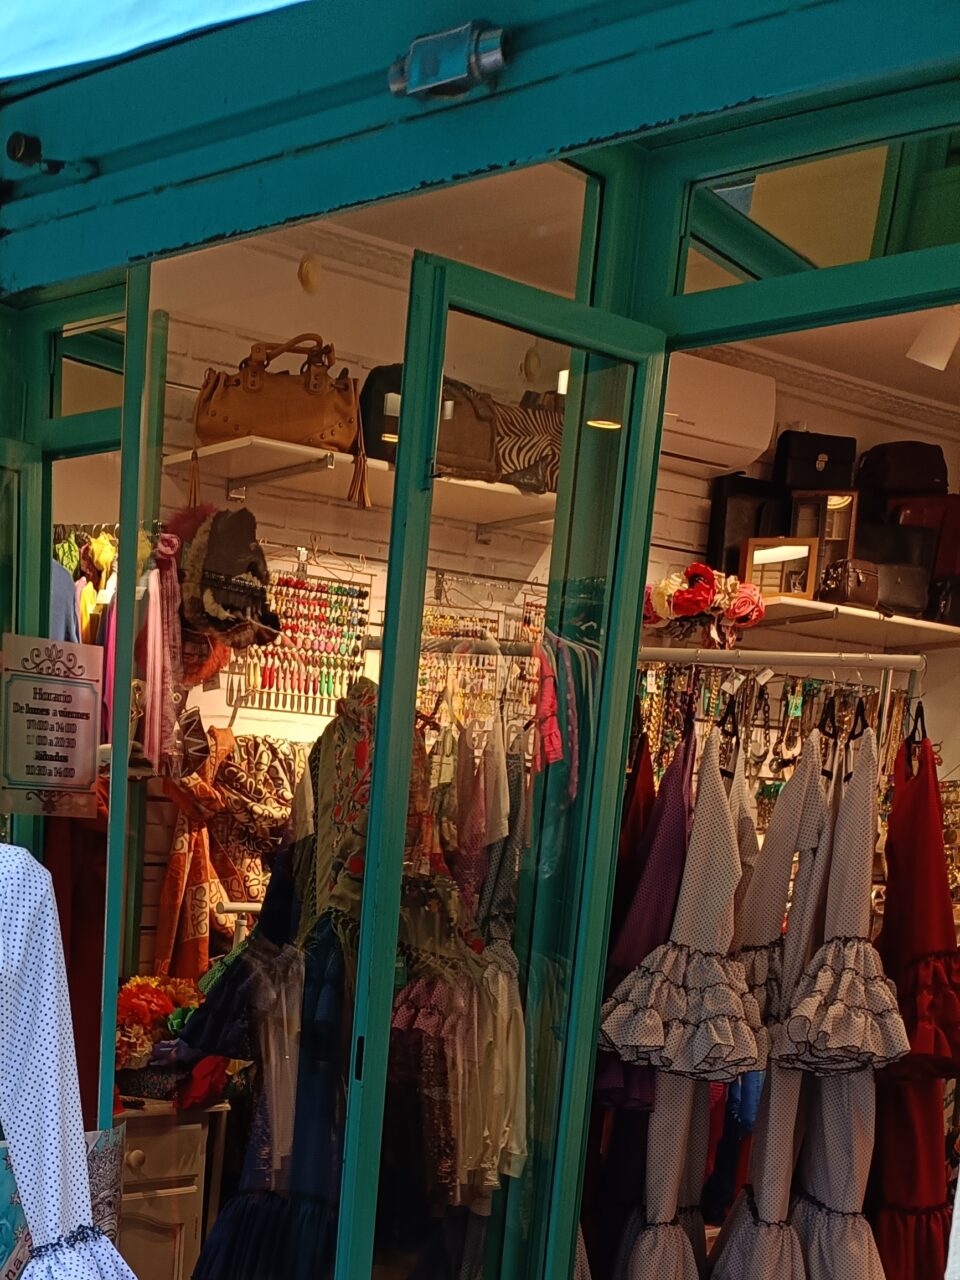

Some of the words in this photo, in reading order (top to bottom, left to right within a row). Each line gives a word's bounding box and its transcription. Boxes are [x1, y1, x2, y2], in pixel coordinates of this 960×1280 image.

[33, 687, 73, 704] Horario
[13, 702, 25, 714] De
[25, 703, 50, 716] lunes
[52, 708, 58, 717] a
[49, 724, 55, 732] a
[48, 739, 53, 747] a
[47, 769, 53, 777] a
